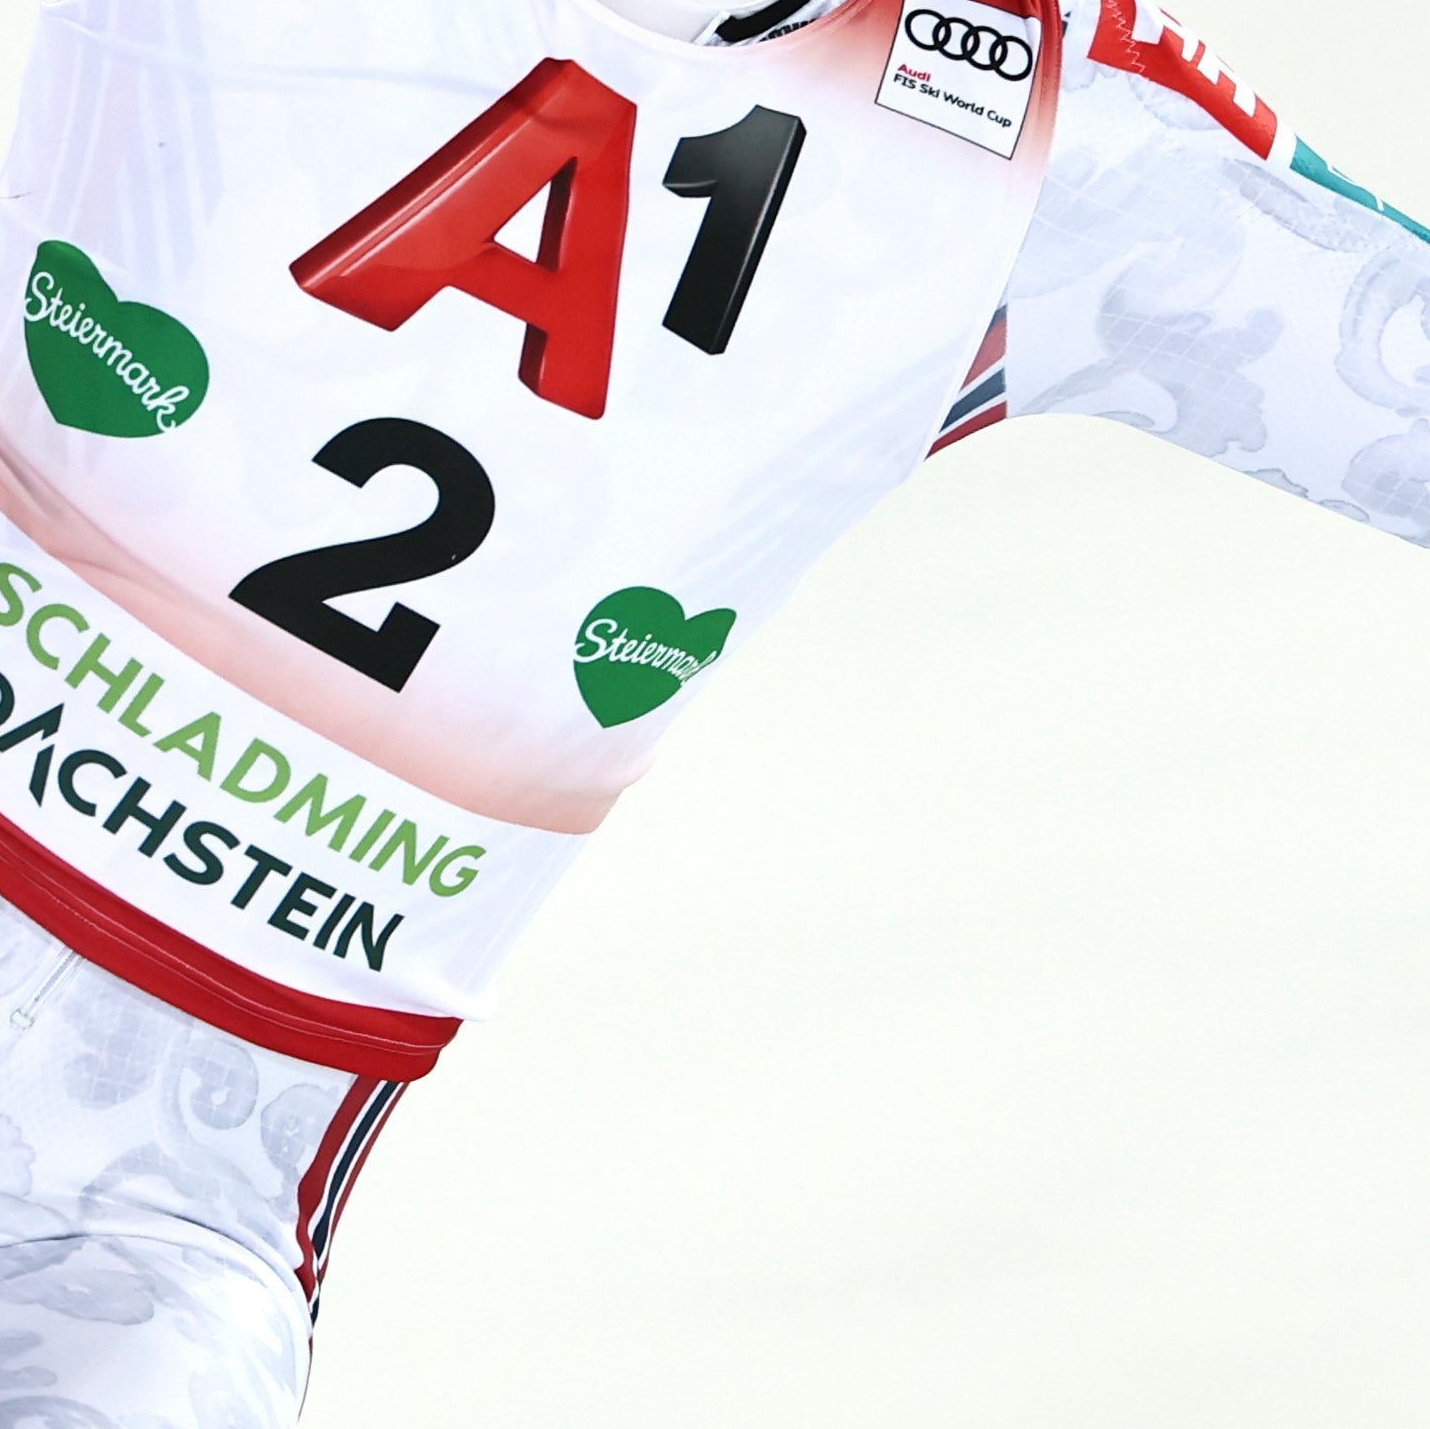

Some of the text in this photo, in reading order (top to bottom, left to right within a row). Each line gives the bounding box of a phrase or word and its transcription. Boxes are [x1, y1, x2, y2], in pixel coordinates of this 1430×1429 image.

[893, 73, 1013, 128] FIS Ski World Cup
[897, 63, 931, 82] Audi
[290, 57, 807, 420] A1
[23, 271, 190, 432] Steiermark
[228, 417, 496, 693] 2
